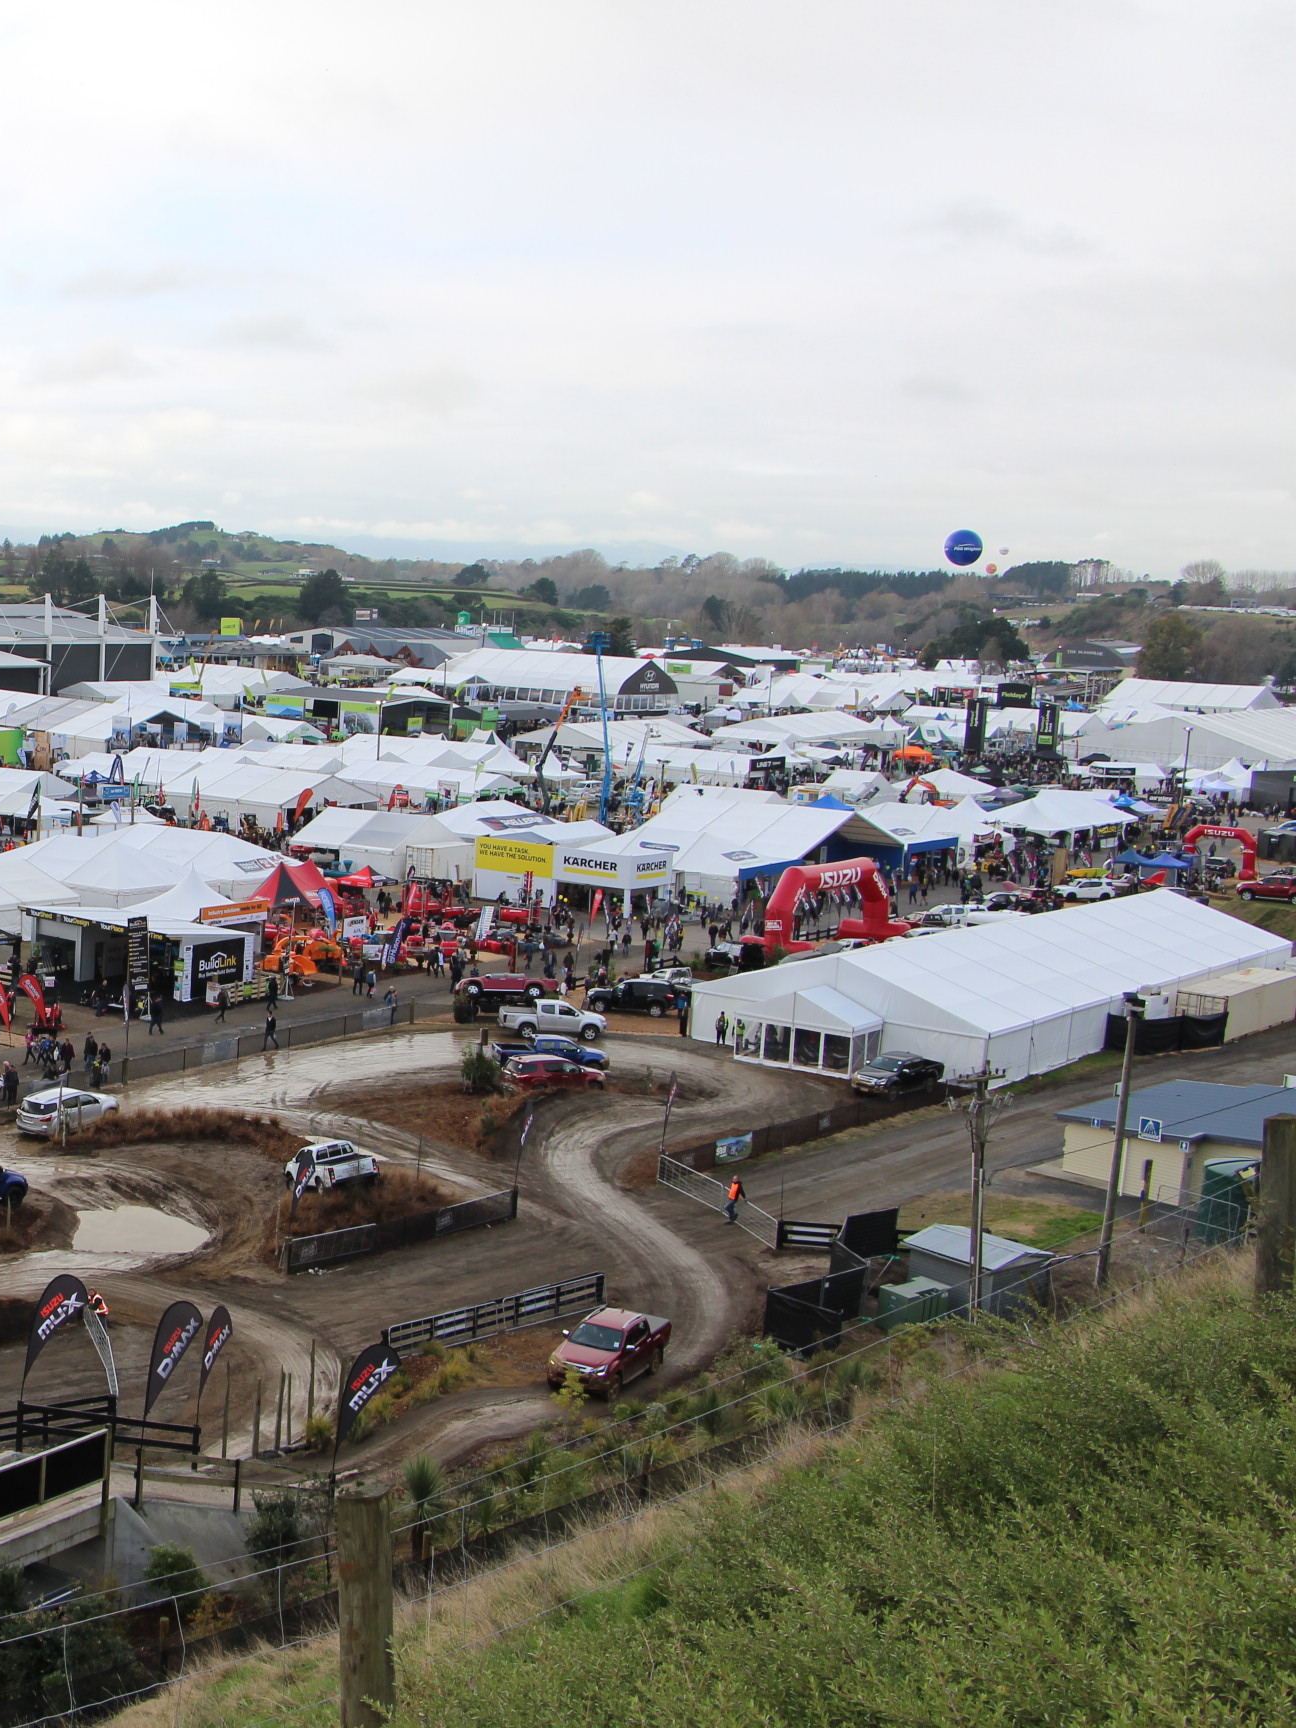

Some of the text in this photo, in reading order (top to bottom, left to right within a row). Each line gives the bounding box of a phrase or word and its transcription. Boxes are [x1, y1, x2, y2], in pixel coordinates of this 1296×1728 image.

[1204, 828, 1235, 837] ISUZU
[518, 854, 547, 863] SOLUTION.
[563, 855, 618, 872] KÄRCHER
[636, 860, 667, 873] KÄRCHER
[819, 867, 861, 889] ISUZU
[30, 909, 53, 919] YourShed
[63, 915, 90, 927] YourDesign
[100, 922, 124, 933] YourPlace
[199, 952, 237, 971] BuildLink
[40, 1292, 64, 1318] ISUZU
[157, 1317, 200, 1380] D-MAX
[163, 1327, 182, 1354] ISUZU
[204, 1324, 231, 1371] D-MAX
[350, 1364, 375, 1391] ISUZU
